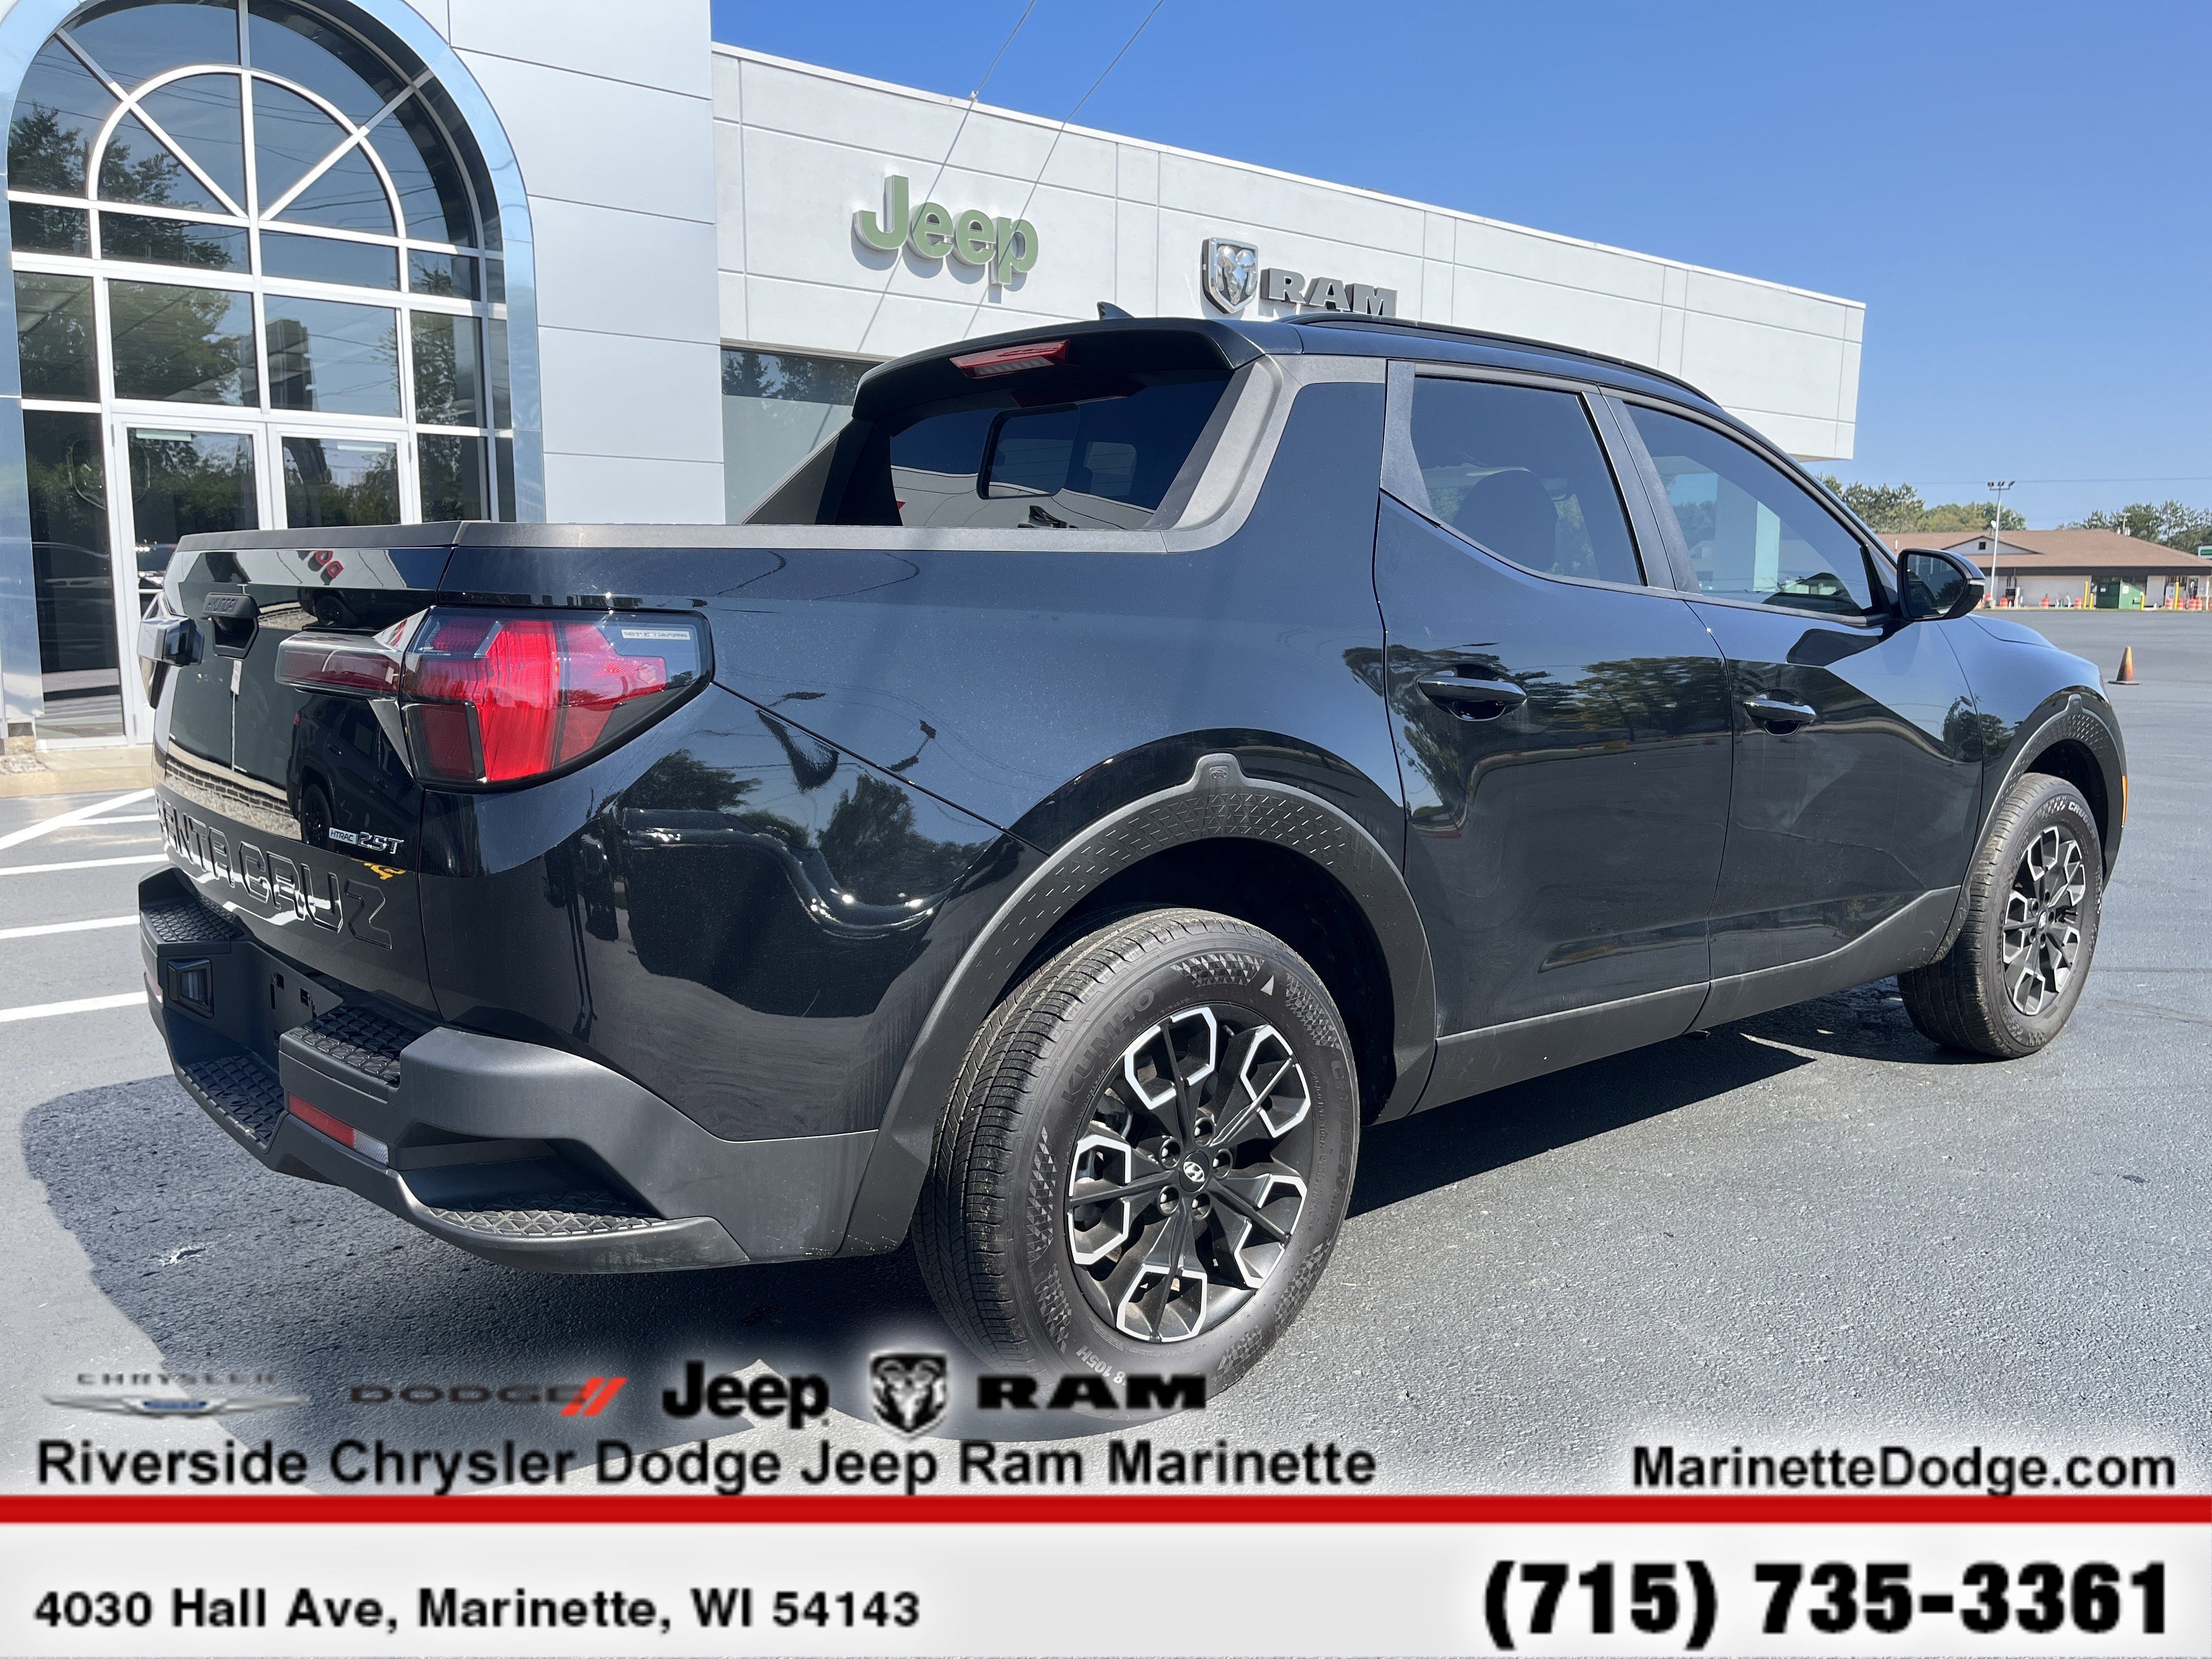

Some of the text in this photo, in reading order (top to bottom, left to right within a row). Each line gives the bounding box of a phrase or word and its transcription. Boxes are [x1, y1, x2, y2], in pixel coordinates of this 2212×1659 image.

[854, 175, 1039, 285] Jeep
[1261, 267, 1398, 318] RAM
[330, 829, 354, 843] HTRAC
[239, 840, 393, 950] CRUZ
[1060, 987, 1155, 1105] KUMHO
[1076, 1344, 1113, 1378] 105H
